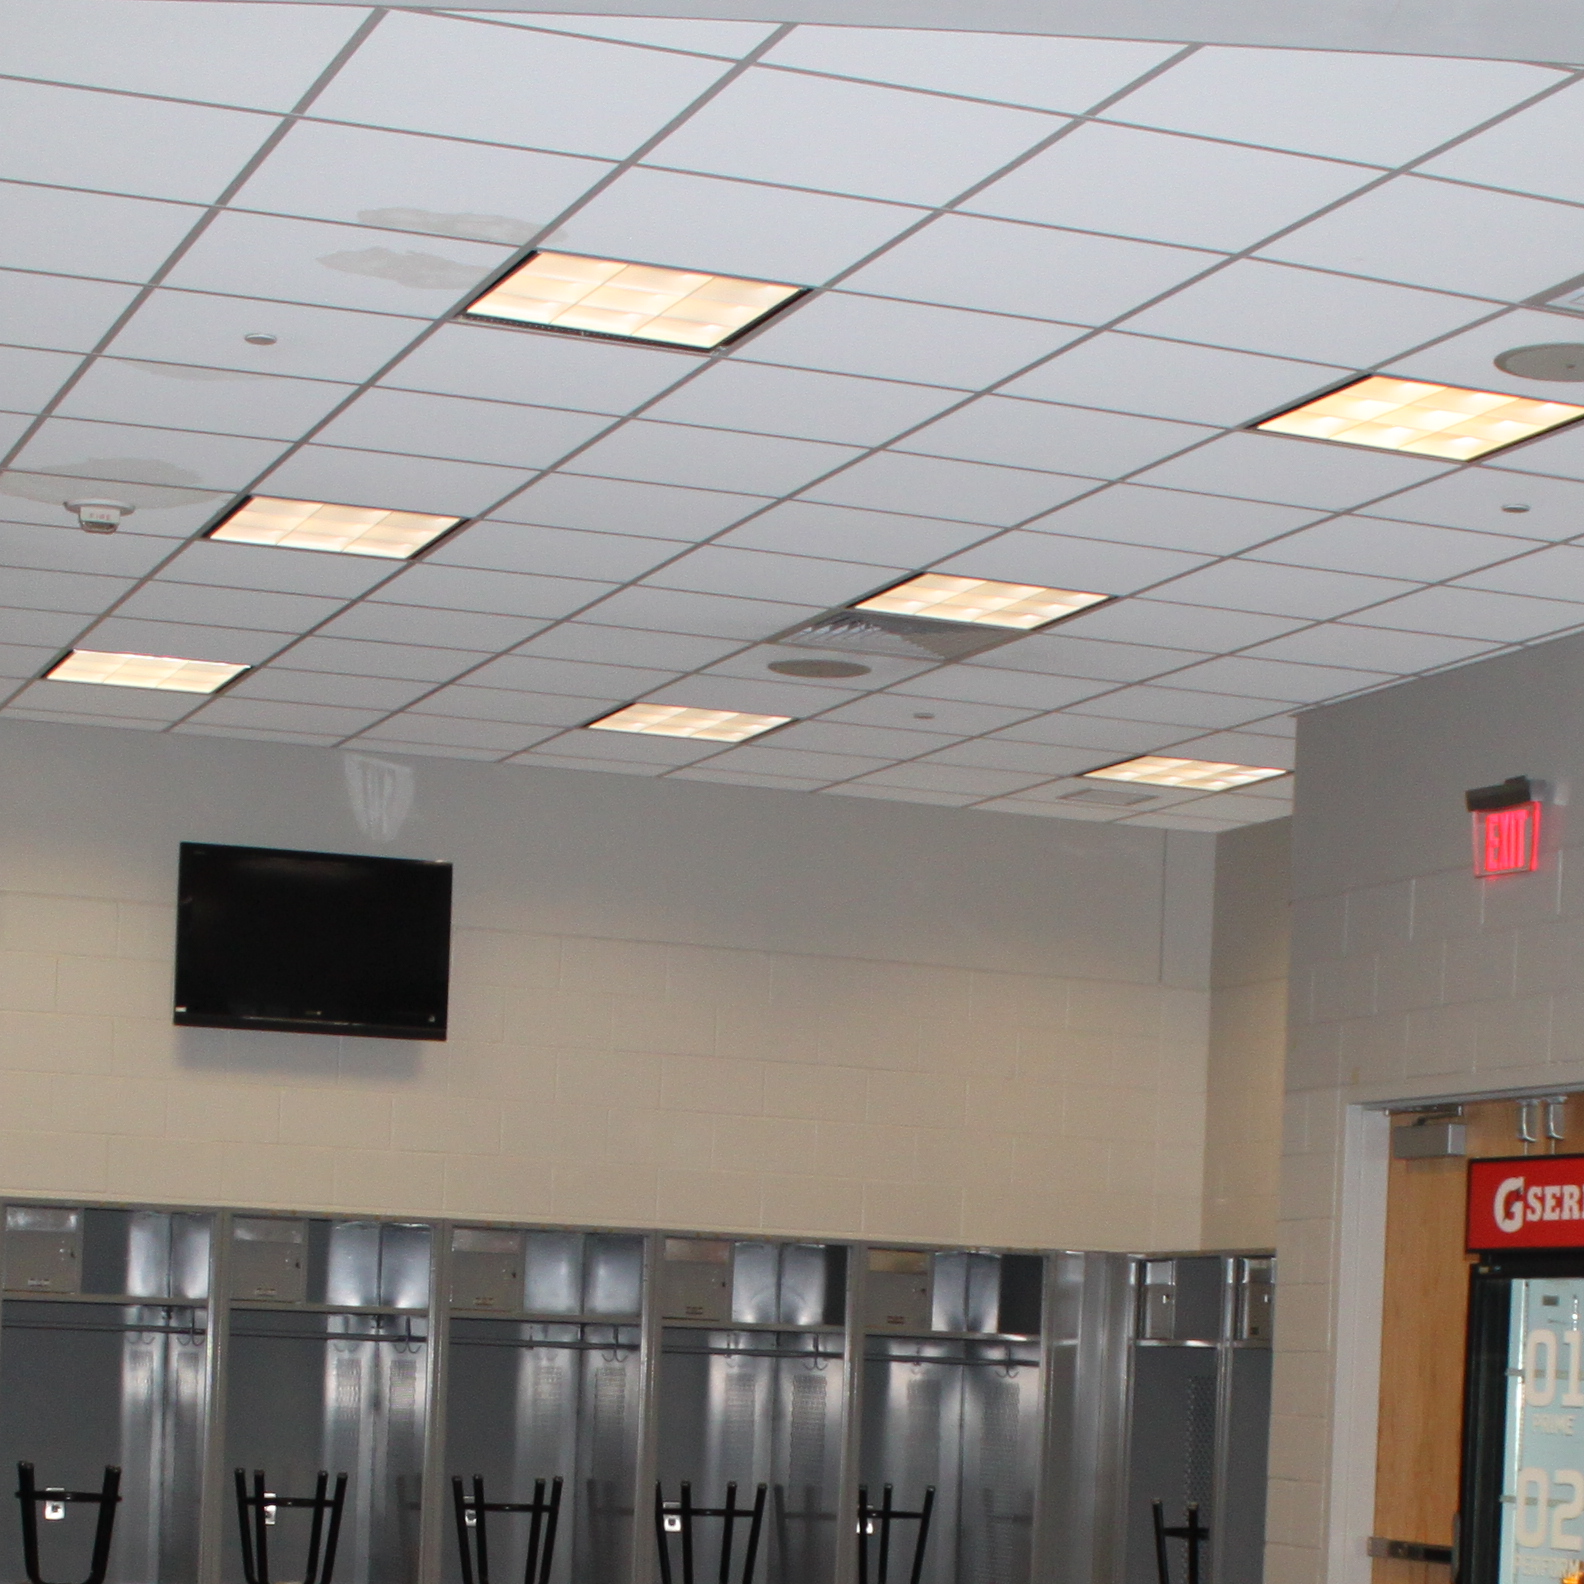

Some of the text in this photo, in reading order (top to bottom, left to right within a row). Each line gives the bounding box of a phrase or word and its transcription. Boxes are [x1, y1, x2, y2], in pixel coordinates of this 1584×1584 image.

[1485, 808, 1530, 872] EXIT
[1532, 1413, 1577, 1436] PRIME
[1514, 1554, 1580, 1579] PERFORM
